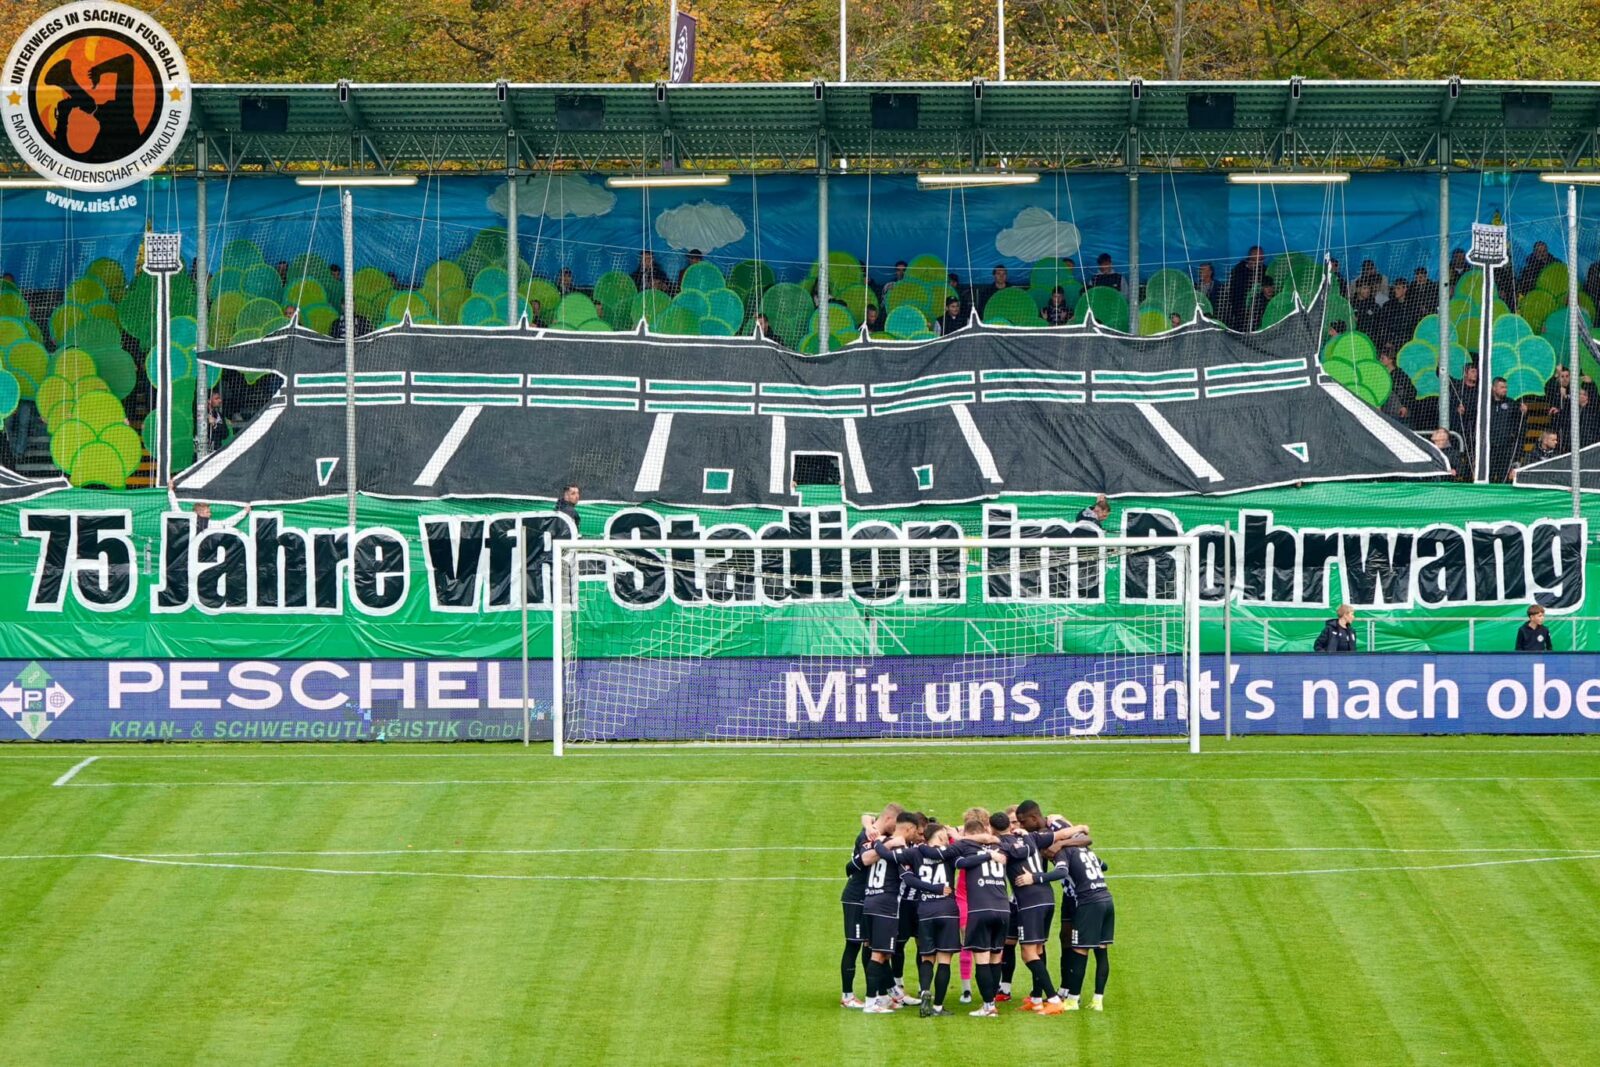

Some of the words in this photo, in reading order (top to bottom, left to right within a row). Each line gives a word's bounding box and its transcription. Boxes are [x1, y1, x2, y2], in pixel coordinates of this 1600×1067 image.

[20, 508, 138, 613] 75
[151, 510, 410, 616] Jahre
[982, 503, 1105, 603] im
[1120, 508, 1588, 615] Rohrwang
[109, 661, 535, 710] PESCHEL
[785, 668, 898, 722] Mit
[925, 680, 1041, 722] uns
[1302, 663, 1459, 720] nach
[109, 720, 183, 738] KRAN-
[191, 720, 204, 738] &
[868, 858, 887, 889] 19
